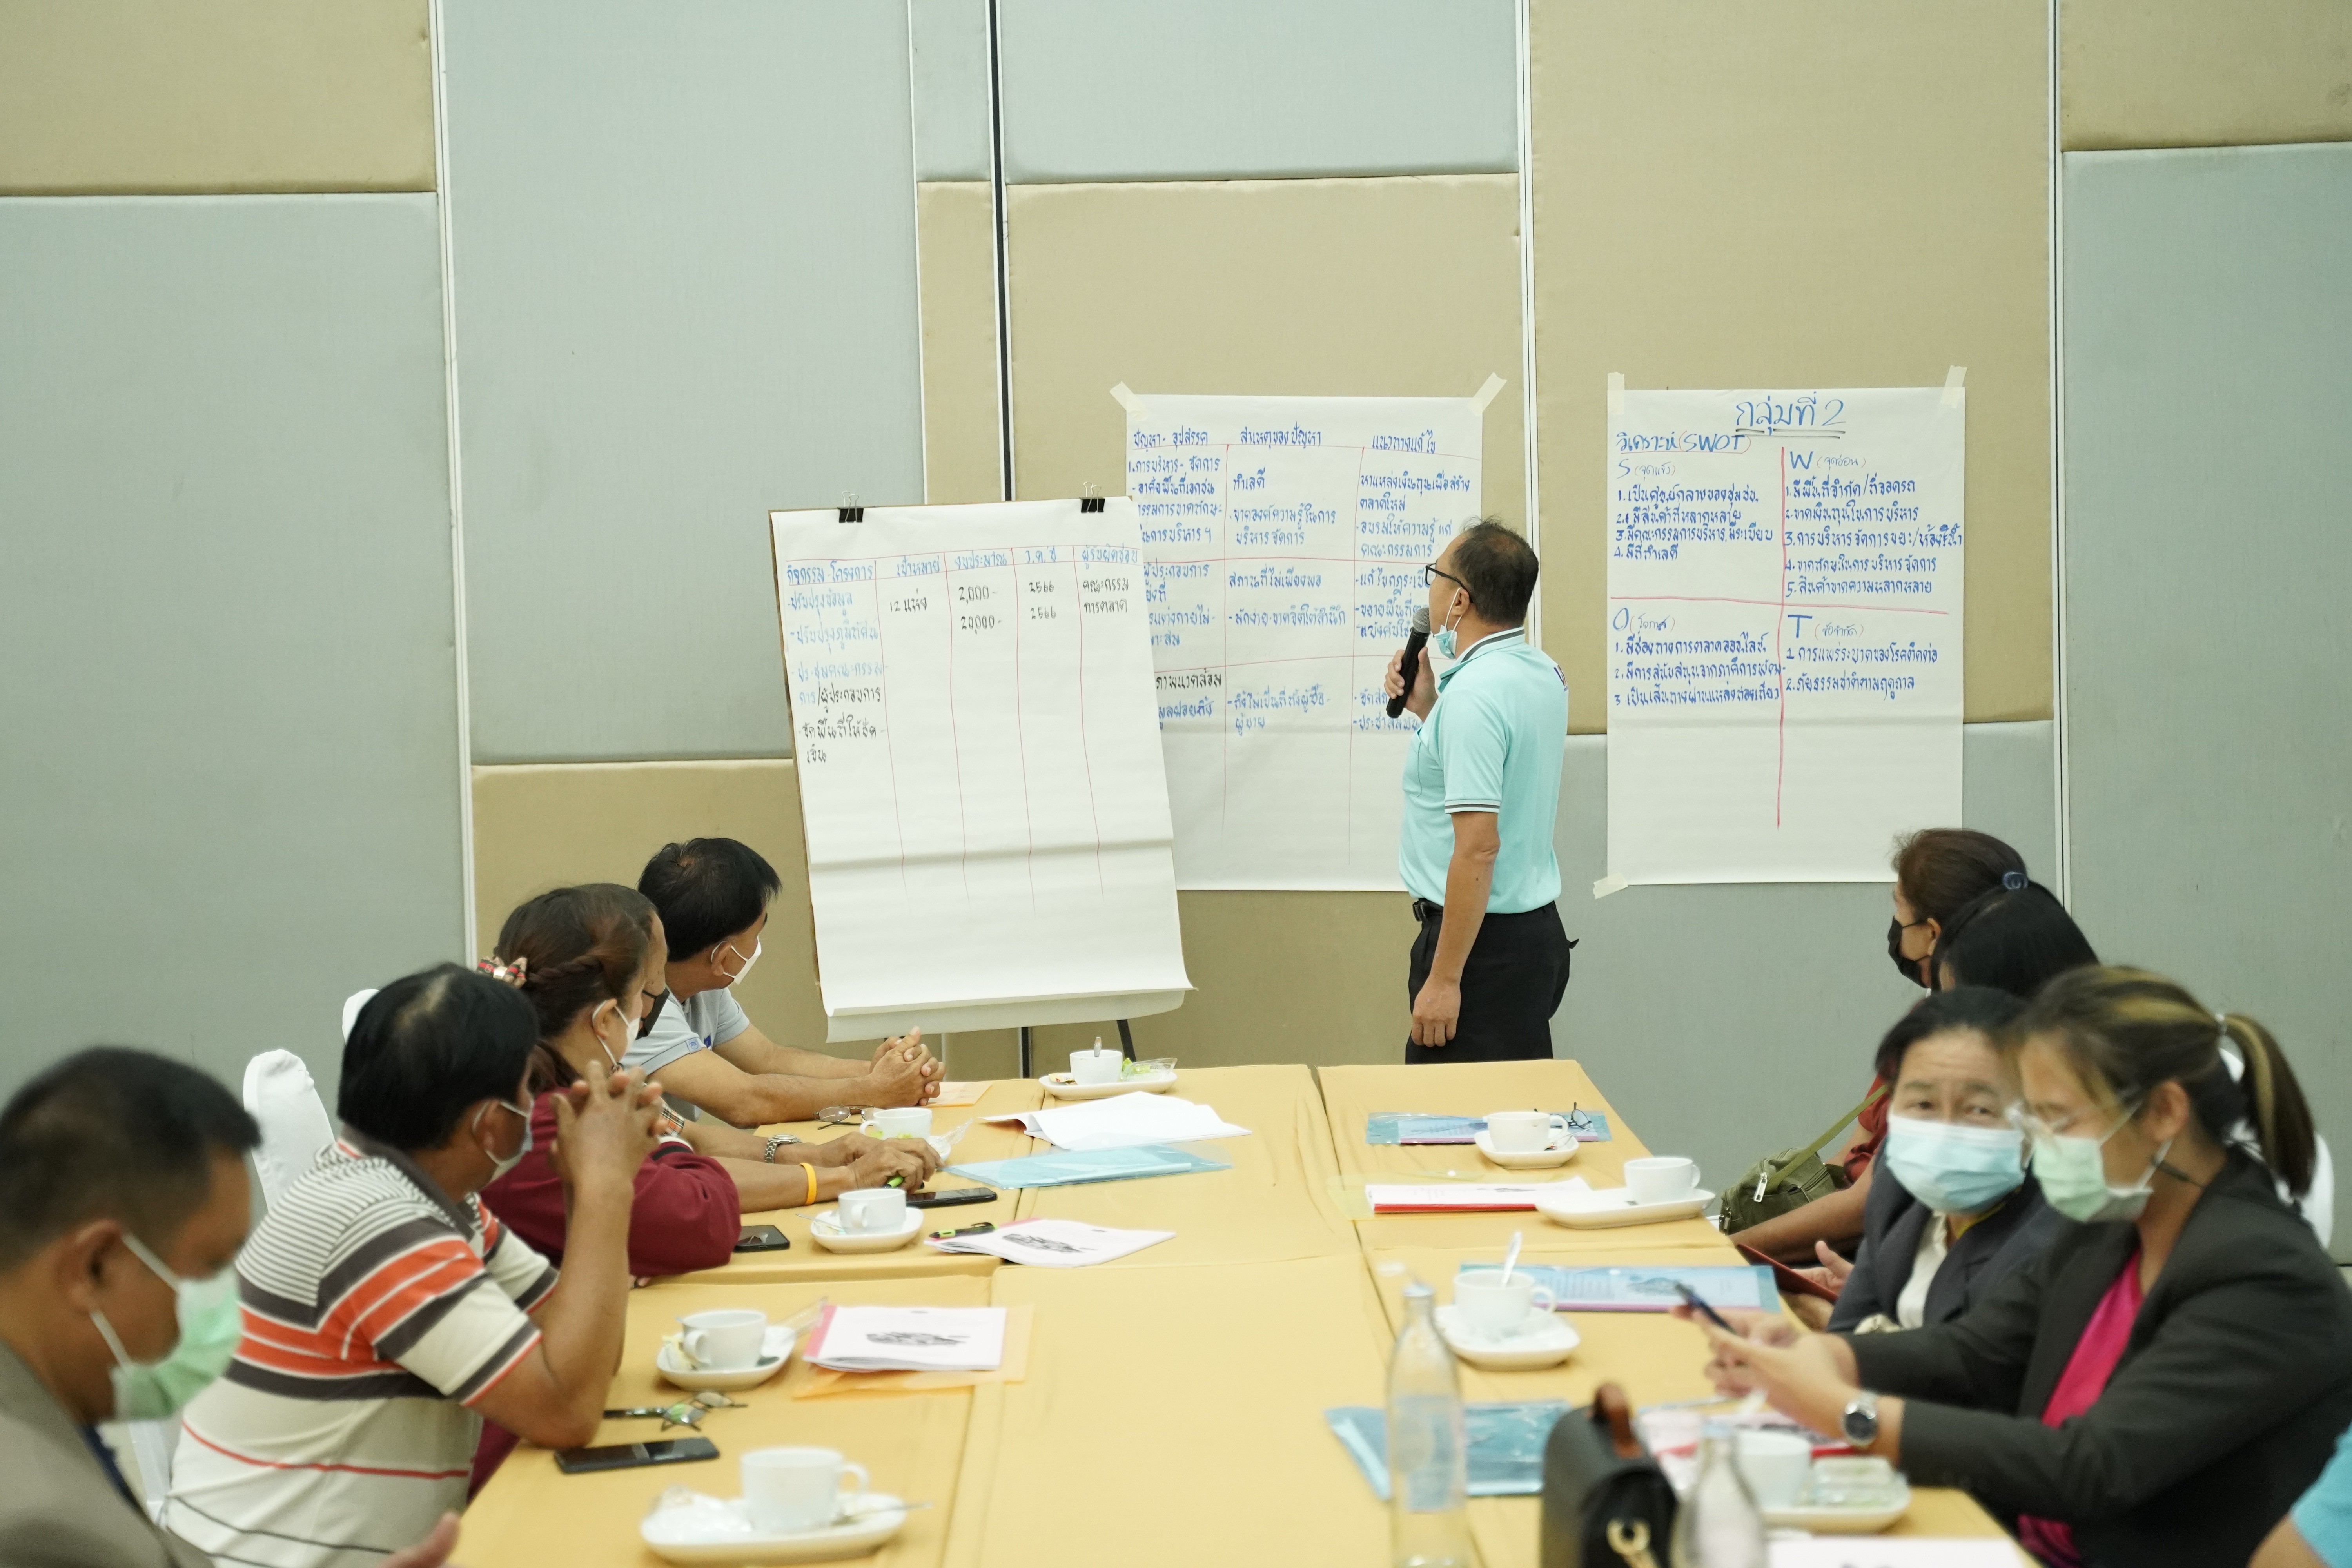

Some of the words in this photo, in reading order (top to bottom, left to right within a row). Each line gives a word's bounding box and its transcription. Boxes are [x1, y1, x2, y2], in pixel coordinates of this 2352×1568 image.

[1736, 393, 1817, 436] กลุ่มที่
[1822, 400, 1846, 426] 2
[1617, 459, 1631, 479] S
[1790, 451, 1813, 469] W
[1788, 615, 1813, 638] T
